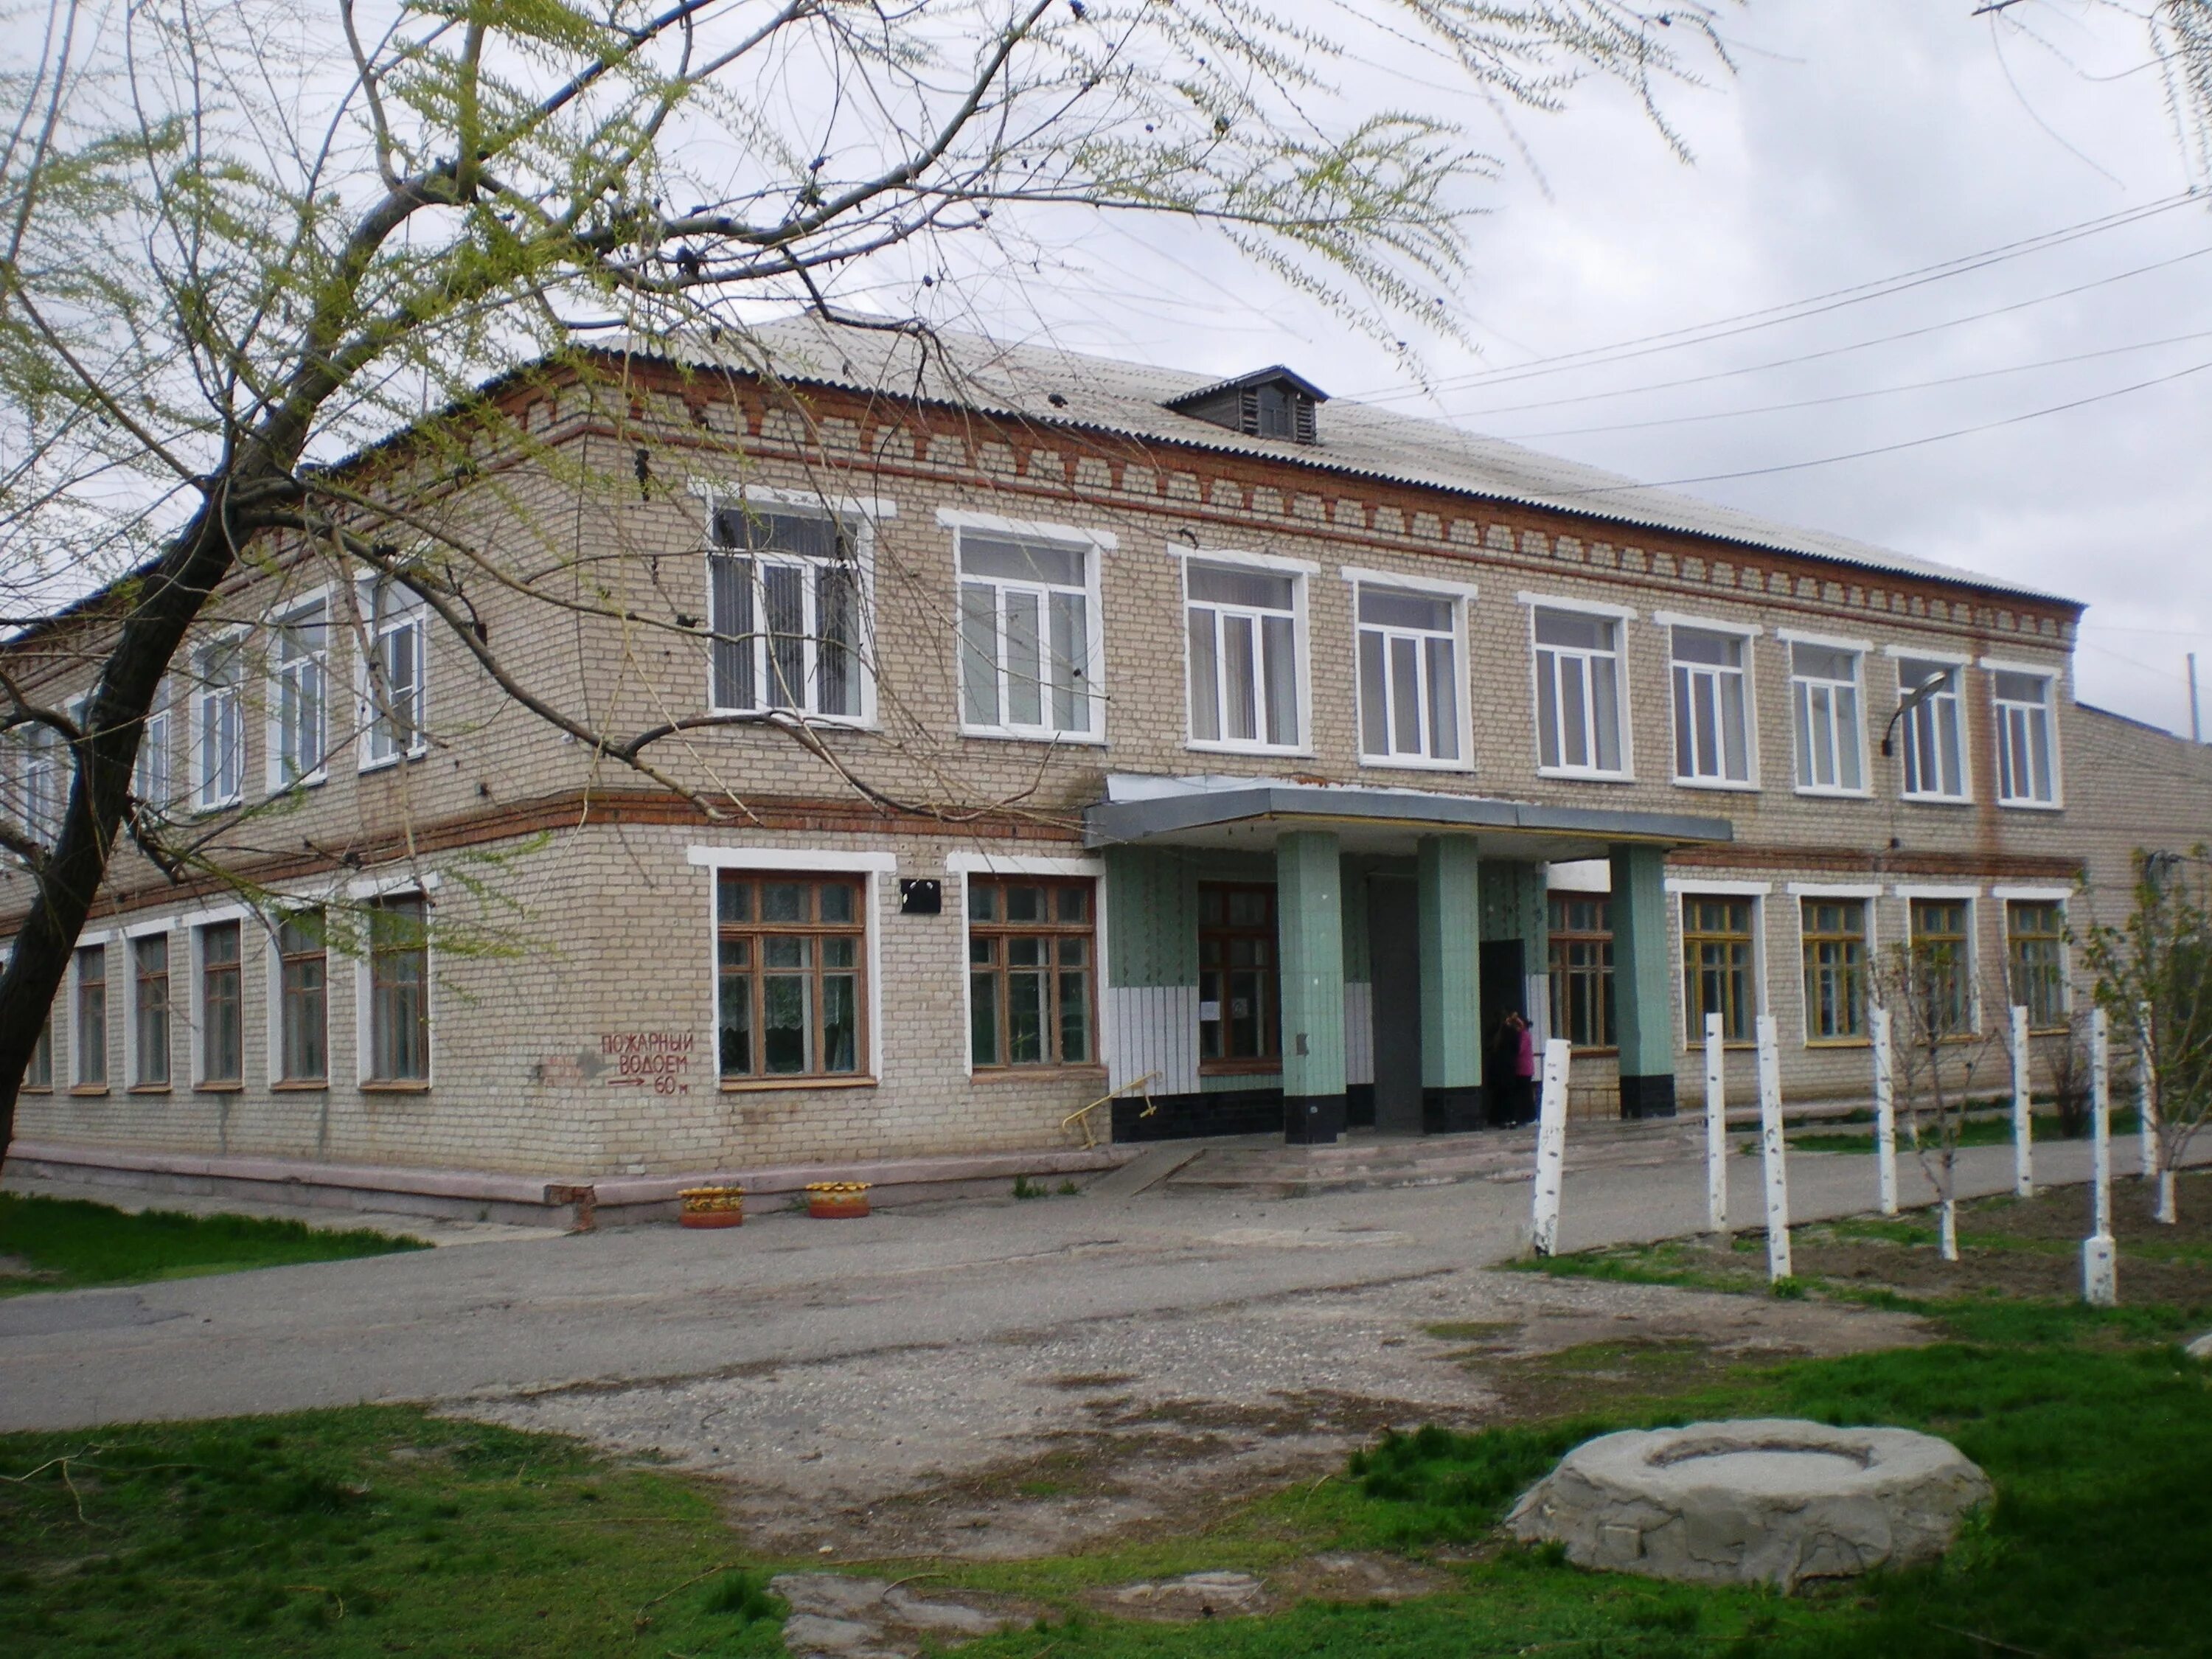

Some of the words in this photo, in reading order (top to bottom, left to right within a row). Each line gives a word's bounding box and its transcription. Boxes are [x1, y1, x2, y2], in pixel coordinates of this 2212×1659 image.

[602, 1030, 694, 1054] ПОЖАРНЫЙ
[619, 1054, 687, 1075] ВОДОЕМ
[654, 1075, 675, 1094] 60
